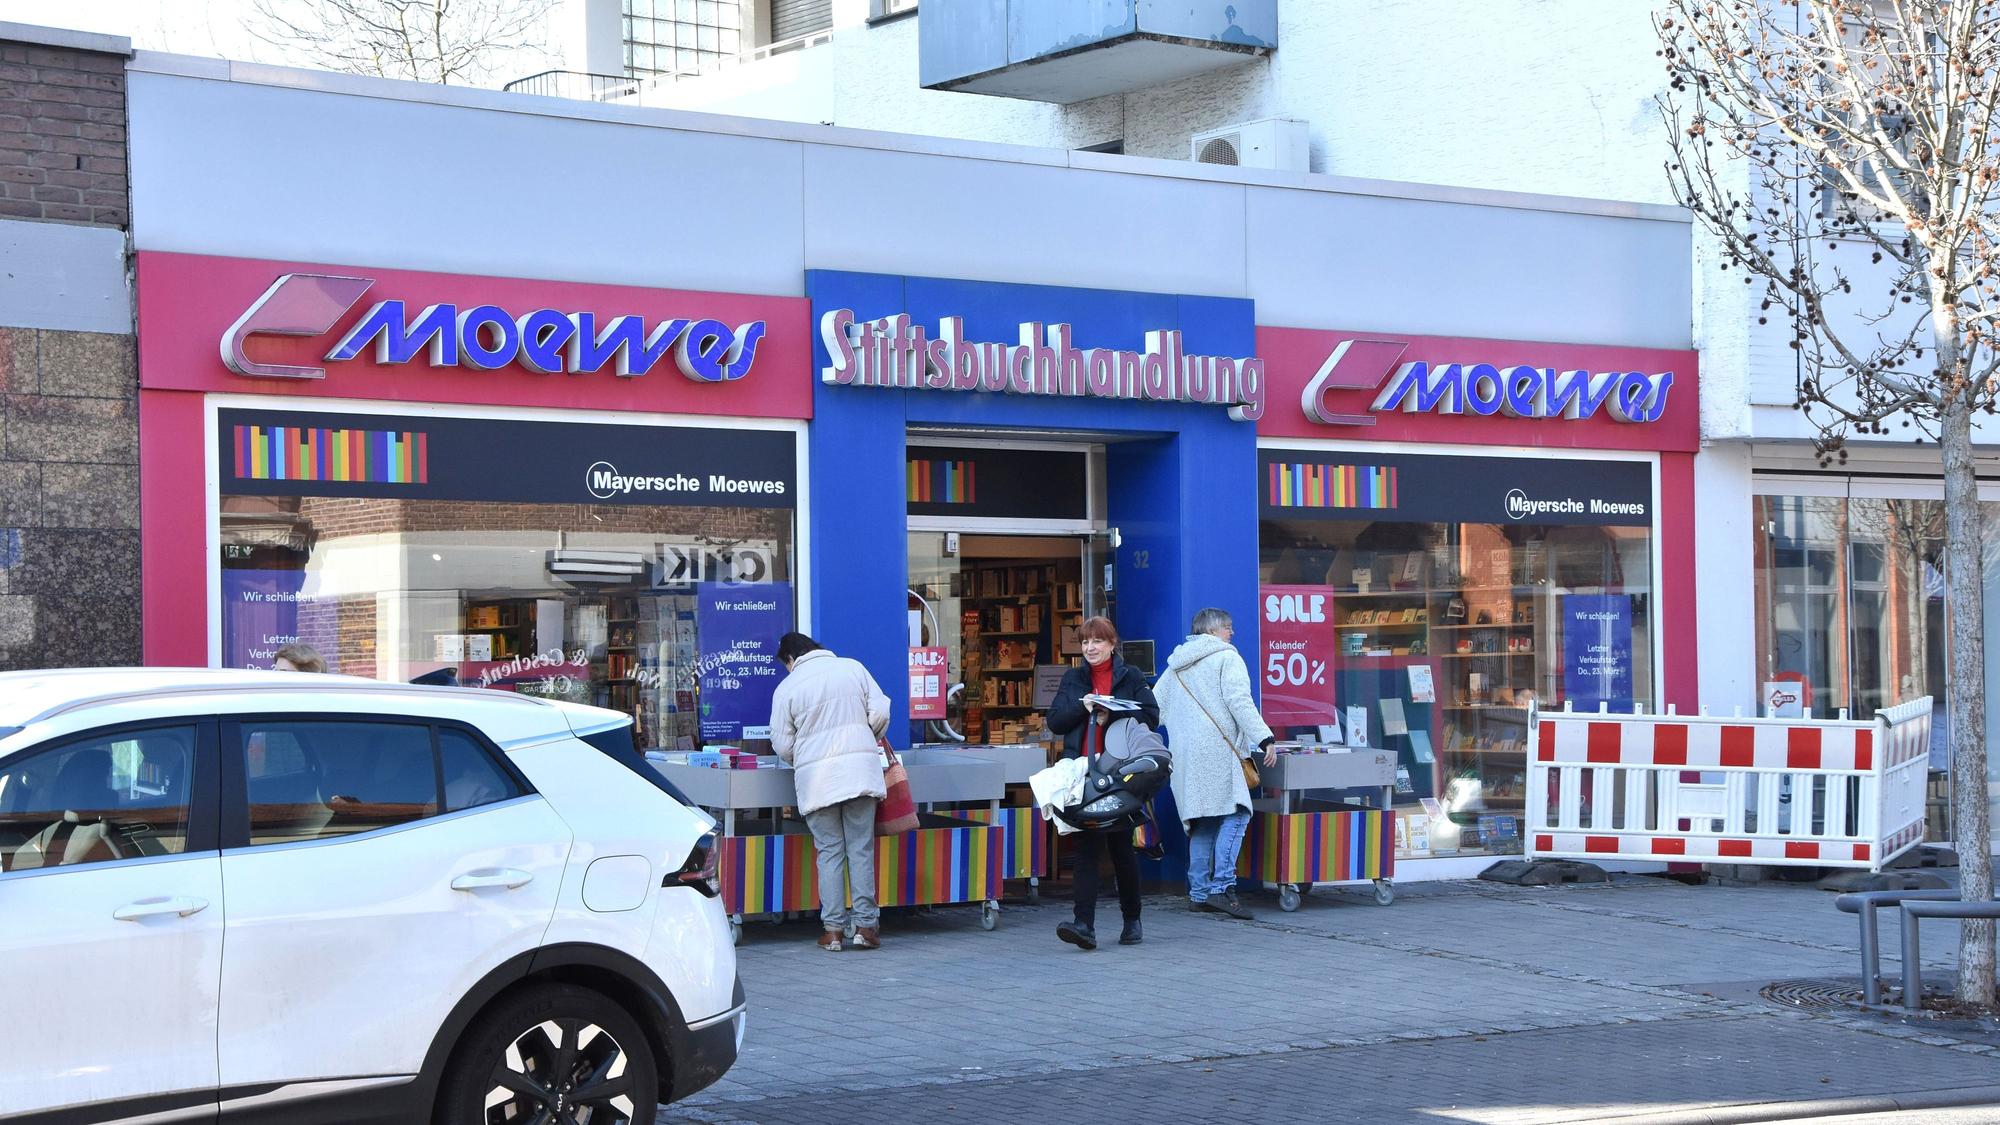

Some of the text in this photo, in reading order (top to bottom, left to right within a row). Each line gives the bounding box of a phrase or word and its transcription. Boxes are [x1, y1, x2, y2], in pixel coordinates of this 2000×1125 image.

[820, 308, 1265, 422] Stiftsbuchhandlung
[593, 471, 785, 494] Mayersche Moewes
[1510, 496, 1645, 515] Mayersche Moewes
[1133, 550, 1150, 568] 32
[243, 591, 262, 602] Wir
[715, 601, 776, 611] Wir schließen!
[1265, 594, 1326, 623] SALE
[1575, 611, 1620, 620] Wir schließen!
[263, 634, 300, 644] Letzter
[731, 640, 762, 649] Letzter
[1587, 644, 1610, 653] Letzter
[720, 653, 774, 664] Verkaufstag:
[718, 666, 776, 677] Do., 23. März
